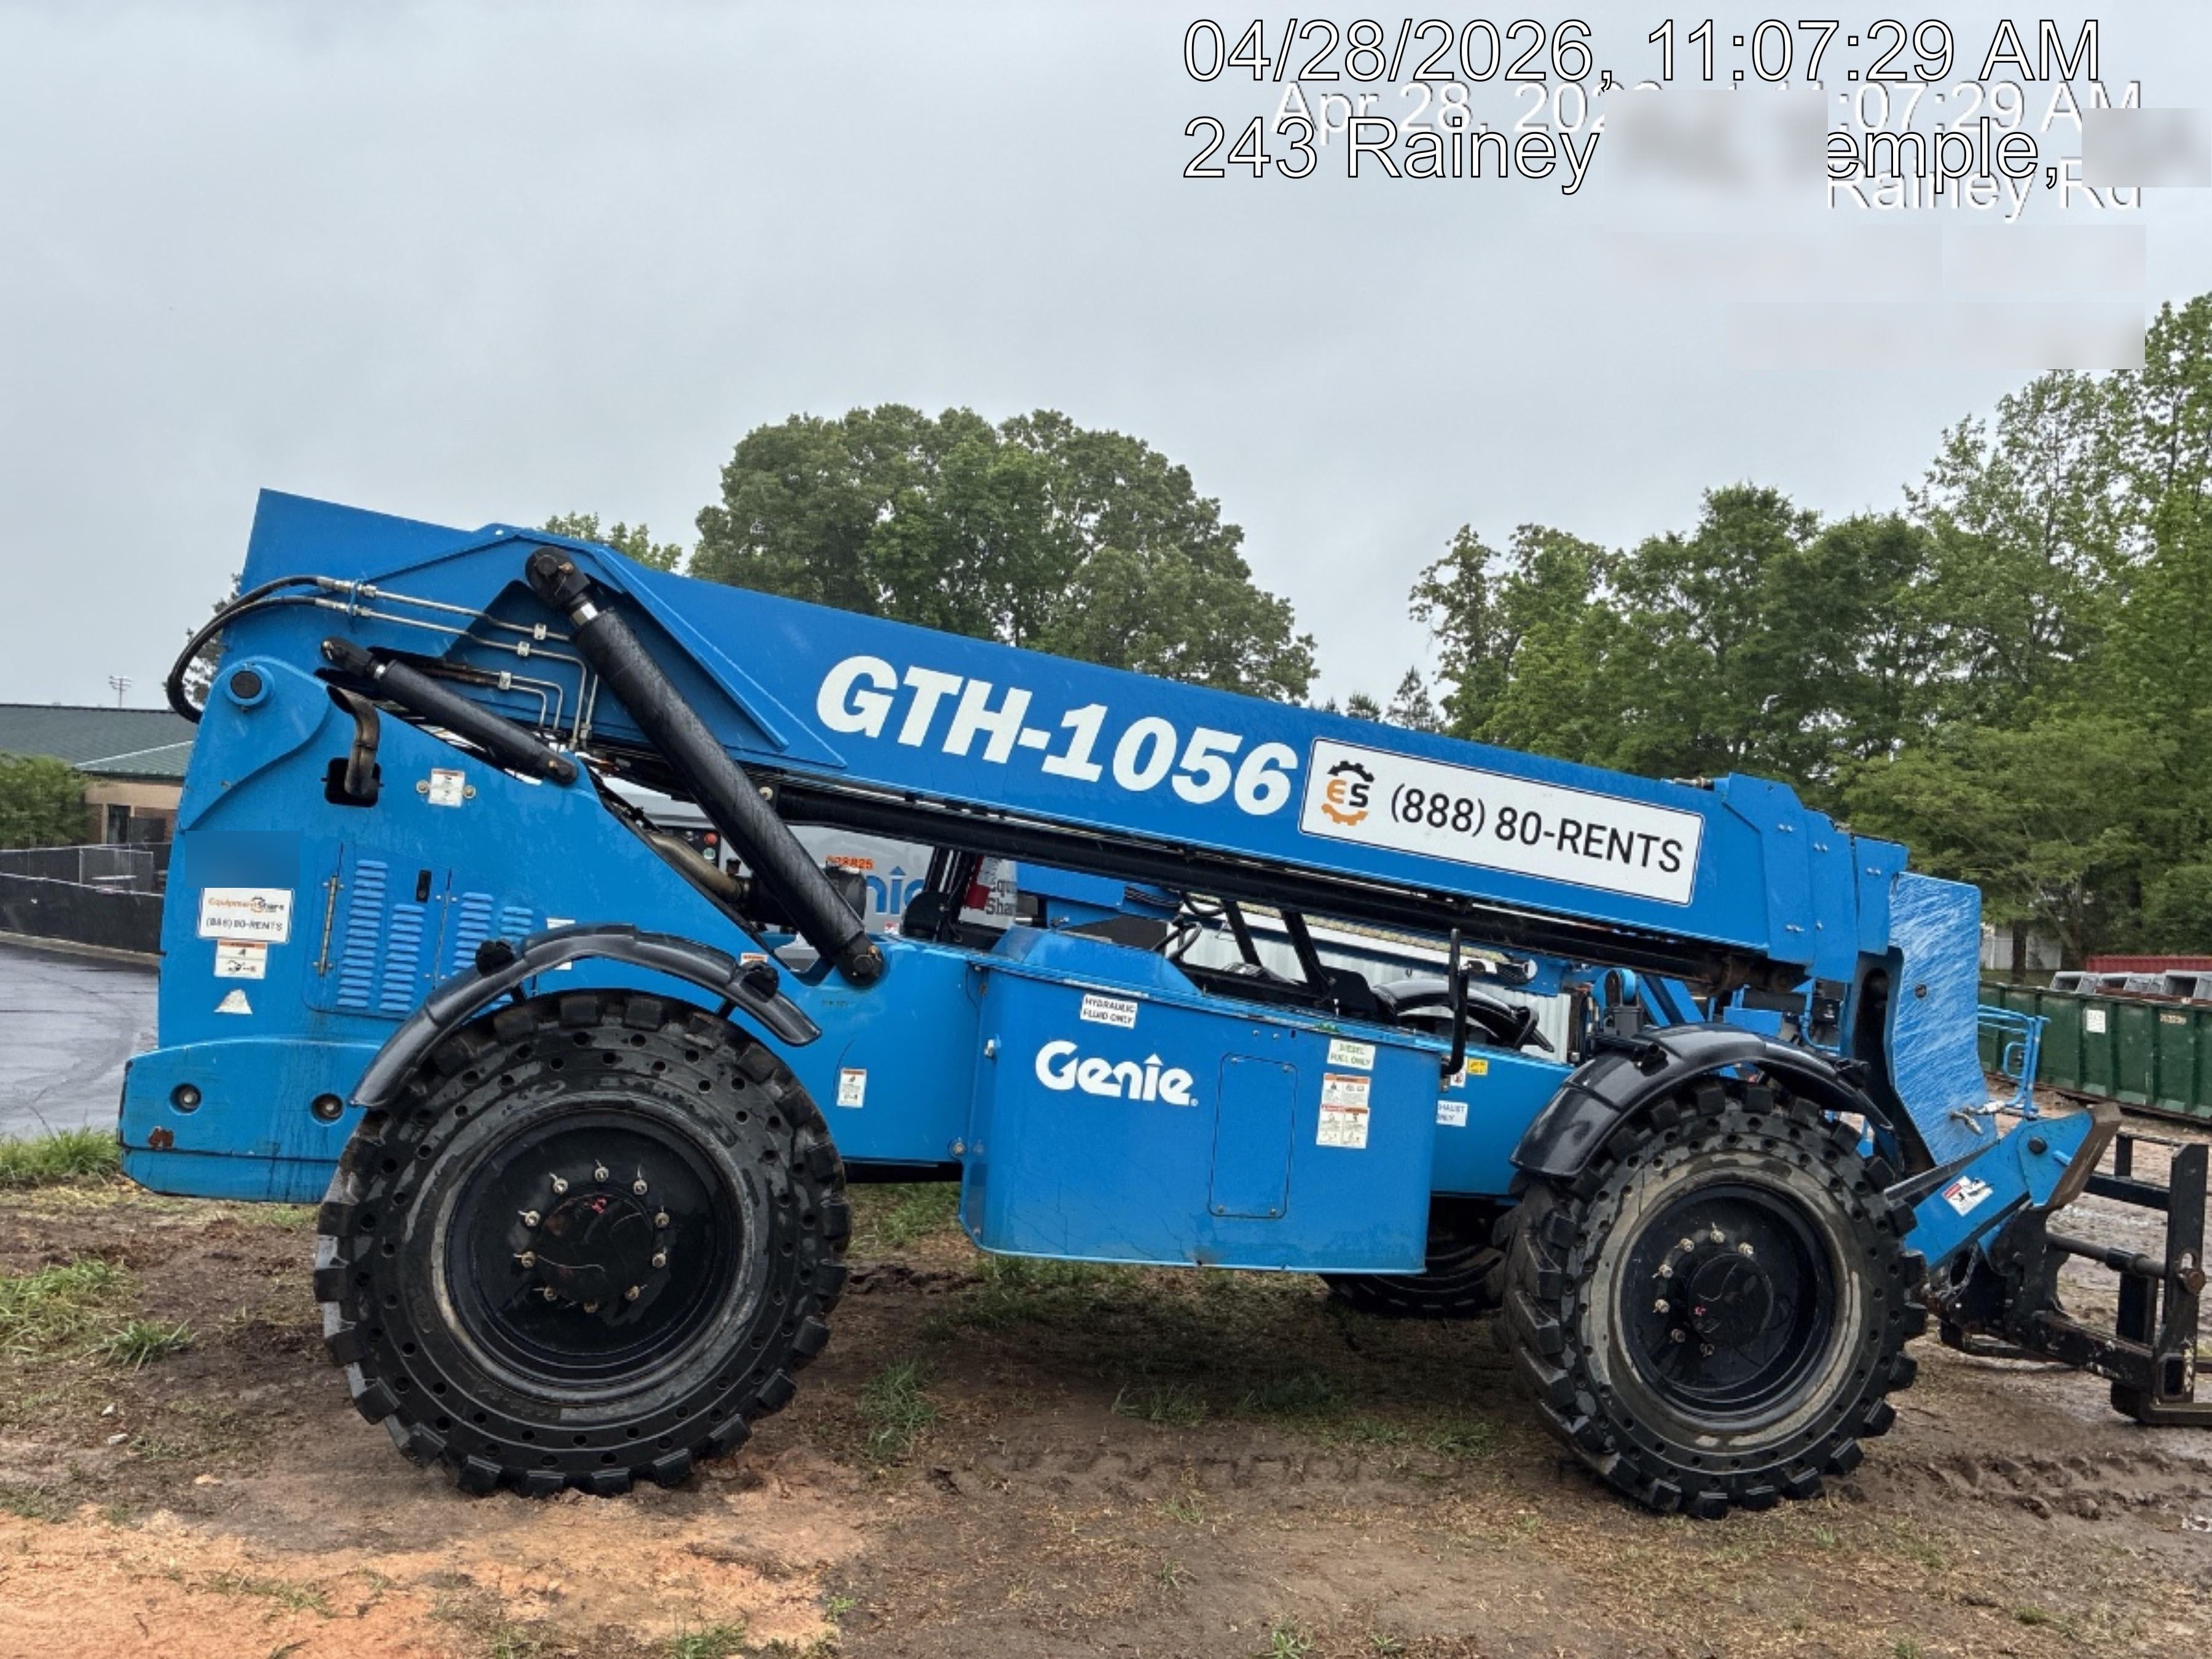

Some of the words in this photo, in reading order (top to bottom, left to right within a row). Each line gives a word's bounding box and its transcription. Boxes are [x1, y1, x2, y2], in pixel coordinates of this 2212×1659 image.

[816, 656, 1298, 815] GTH-1056
[1391, 783, 1486, 837] (888)
[1494, 806, 1684, 873] 80-RENTS
